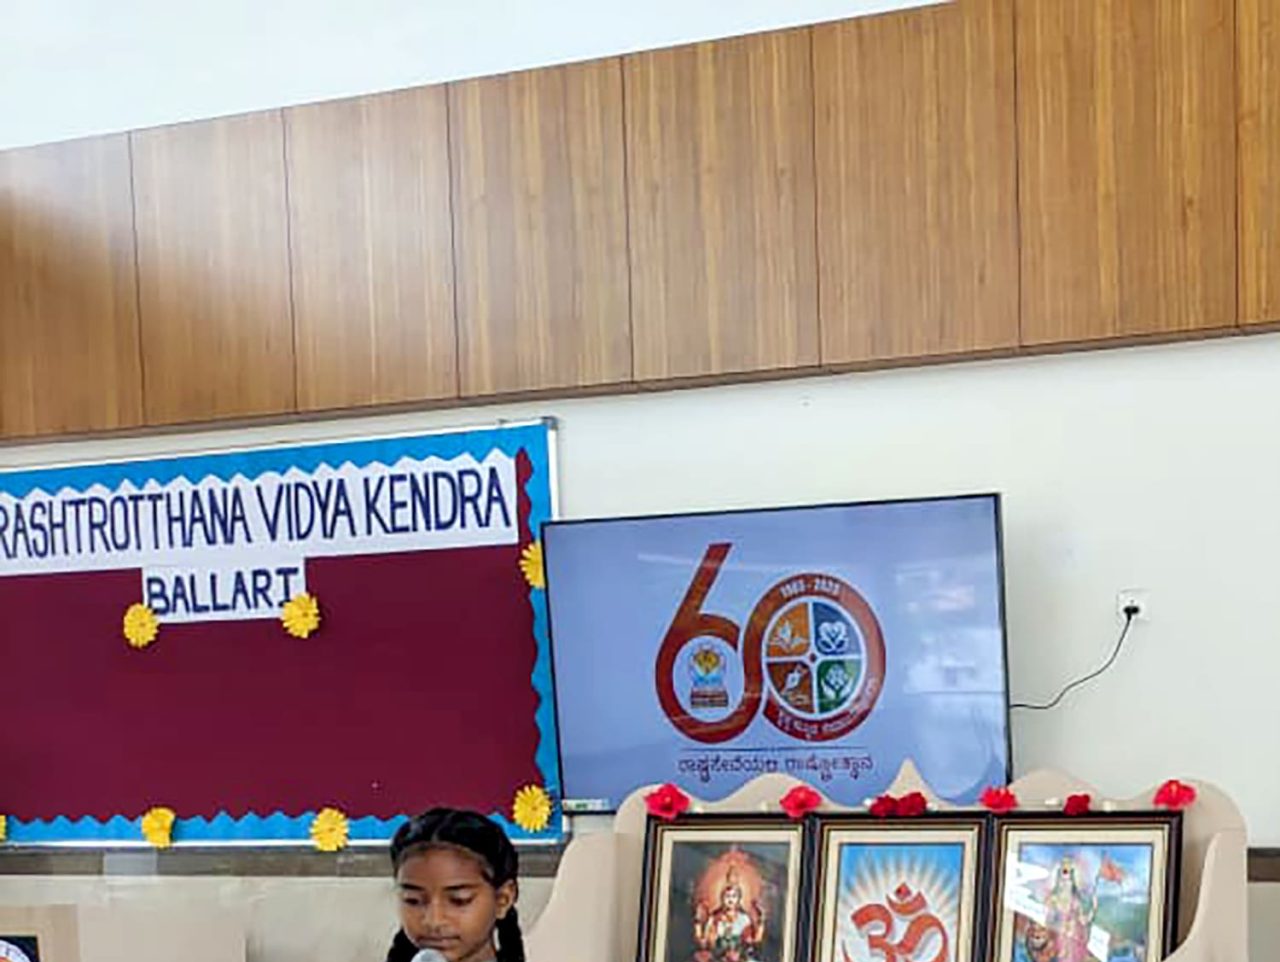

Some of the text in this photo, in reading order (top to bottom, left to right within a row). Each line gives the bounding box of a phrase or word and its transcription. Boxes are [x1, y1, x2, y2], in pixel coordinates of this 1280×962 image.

[0, 466, 511, 559] RASHTROTTHANA VIDYA KENDRA
